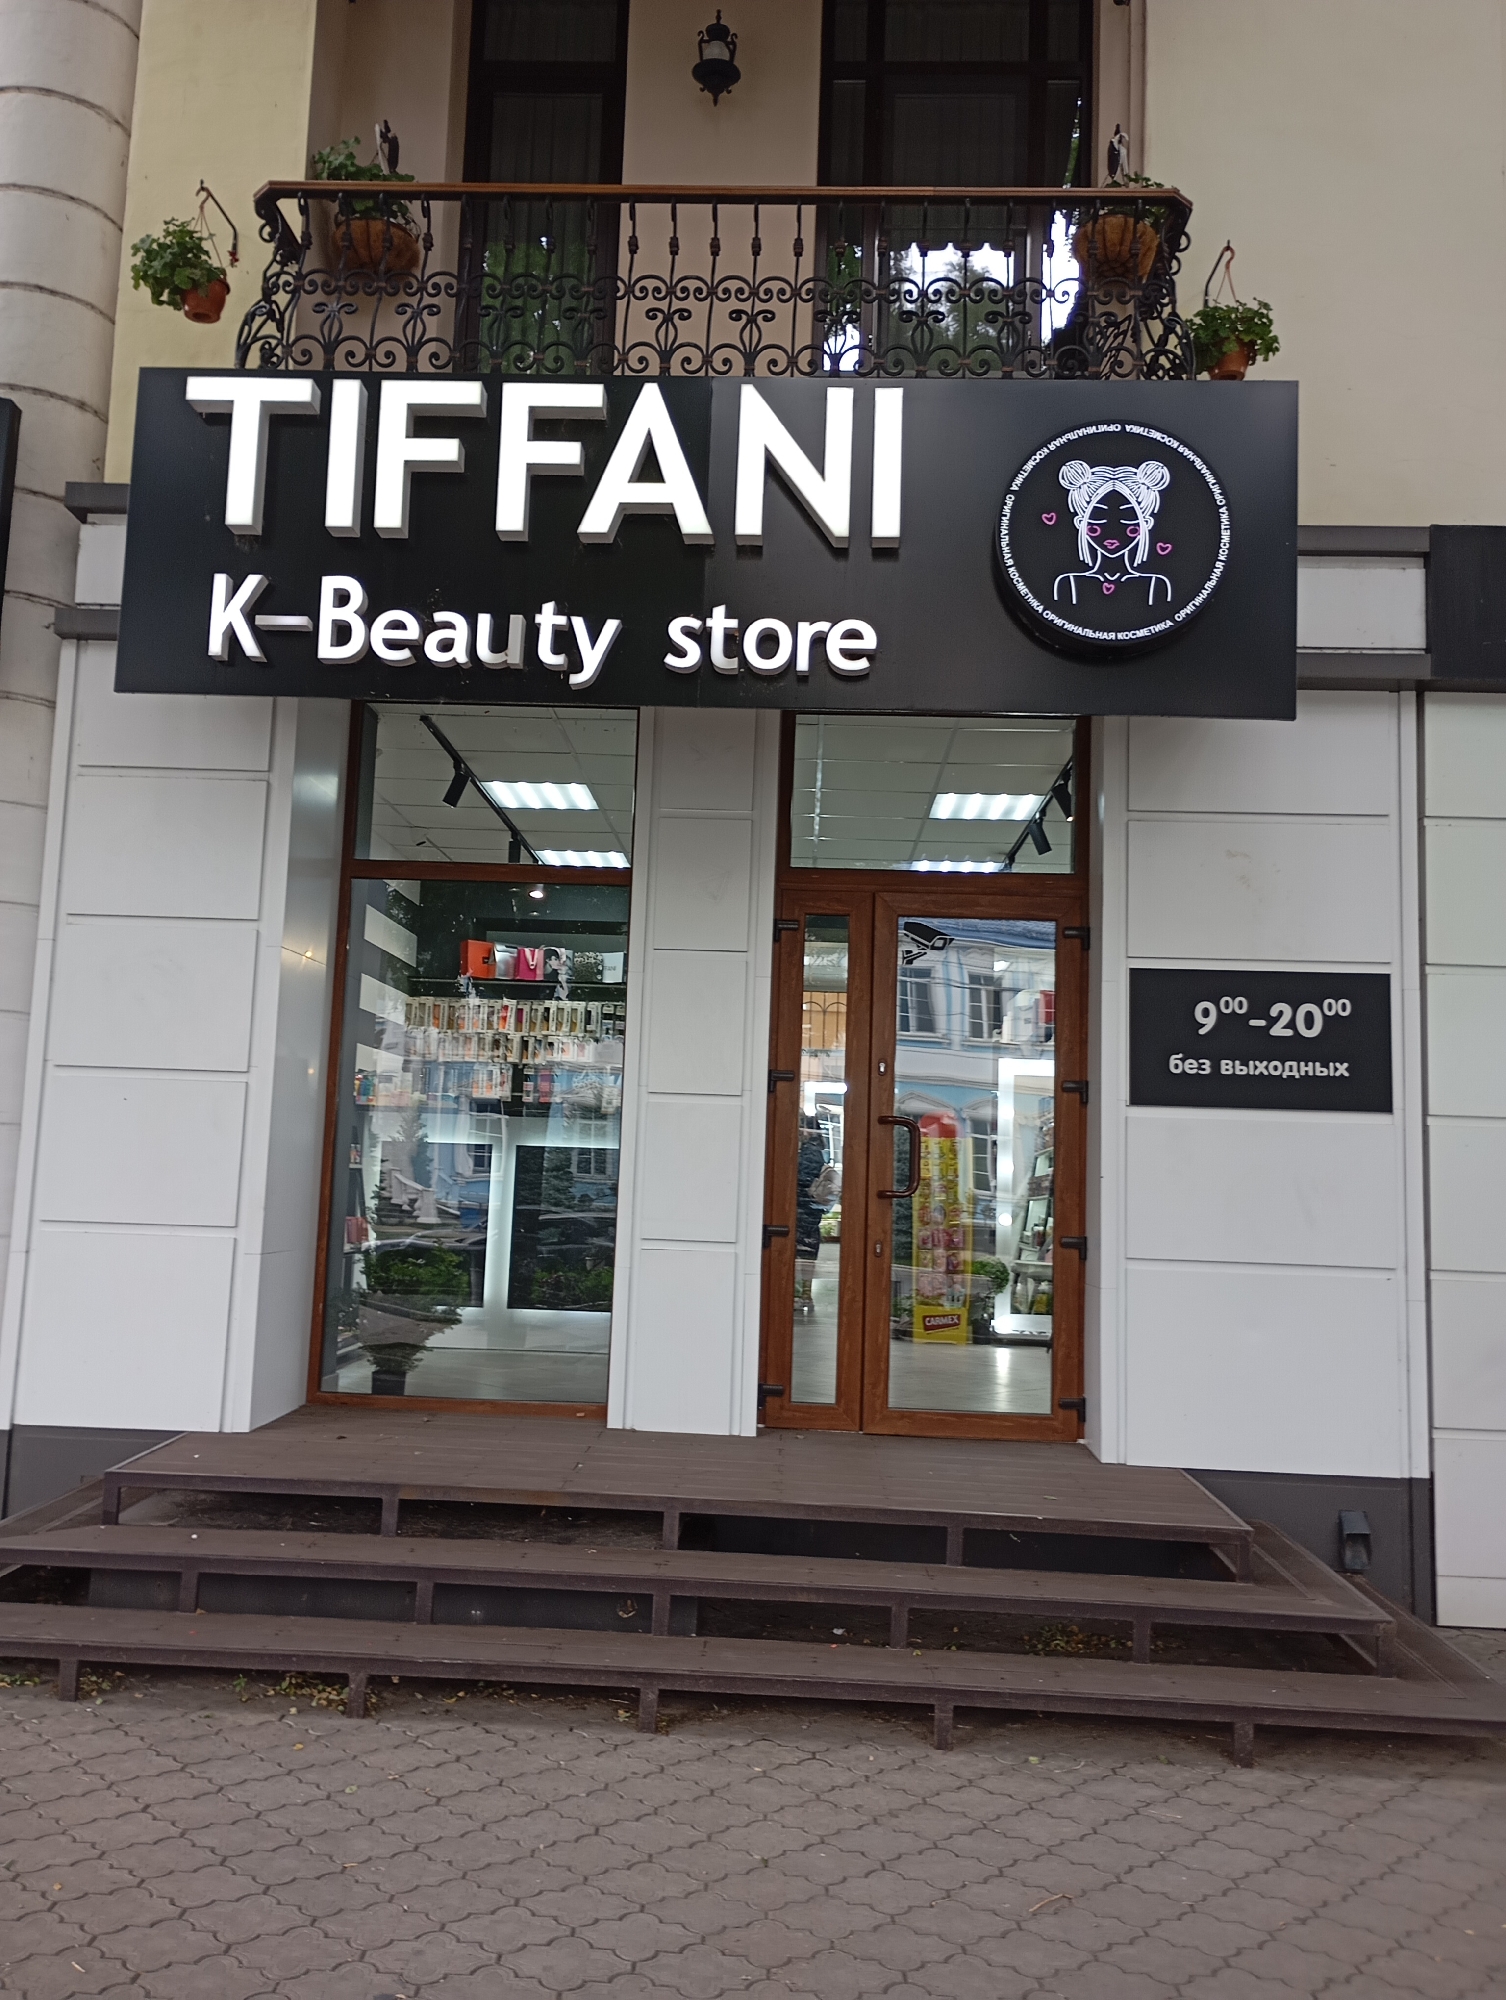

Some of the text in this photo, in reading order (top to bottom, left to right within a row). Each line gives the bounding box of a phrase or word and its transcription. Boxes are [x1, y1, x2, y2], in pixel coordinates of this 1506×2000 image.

[186, 376, 904, 548] TIFFANI
[1009, 424, 1121, 491] ОРИГИНАЛЬНАЯ КОСМЕТИКА
[1124, 424, 1226, 506] ОРИГИНАЛЬНАЯ КОСМЕТИКА
[1000, 494, 1044, 614] ОРИГИНАЛЬНАЯ КОСМЕТИКА
[1174, 506, 1231, 622] ОРИГИНАЛЬНАЯ КОСМЕТИКА
[207, 572, 878, 690] K-Beauty store
[1042, 610, 1174, 640] ОРИГИНАЛЬНАЯ КОСМЕТИКА
[1168, 1053, 1350, 1079] без выходных
[925, 1315, 959, 1326] CARMEX
